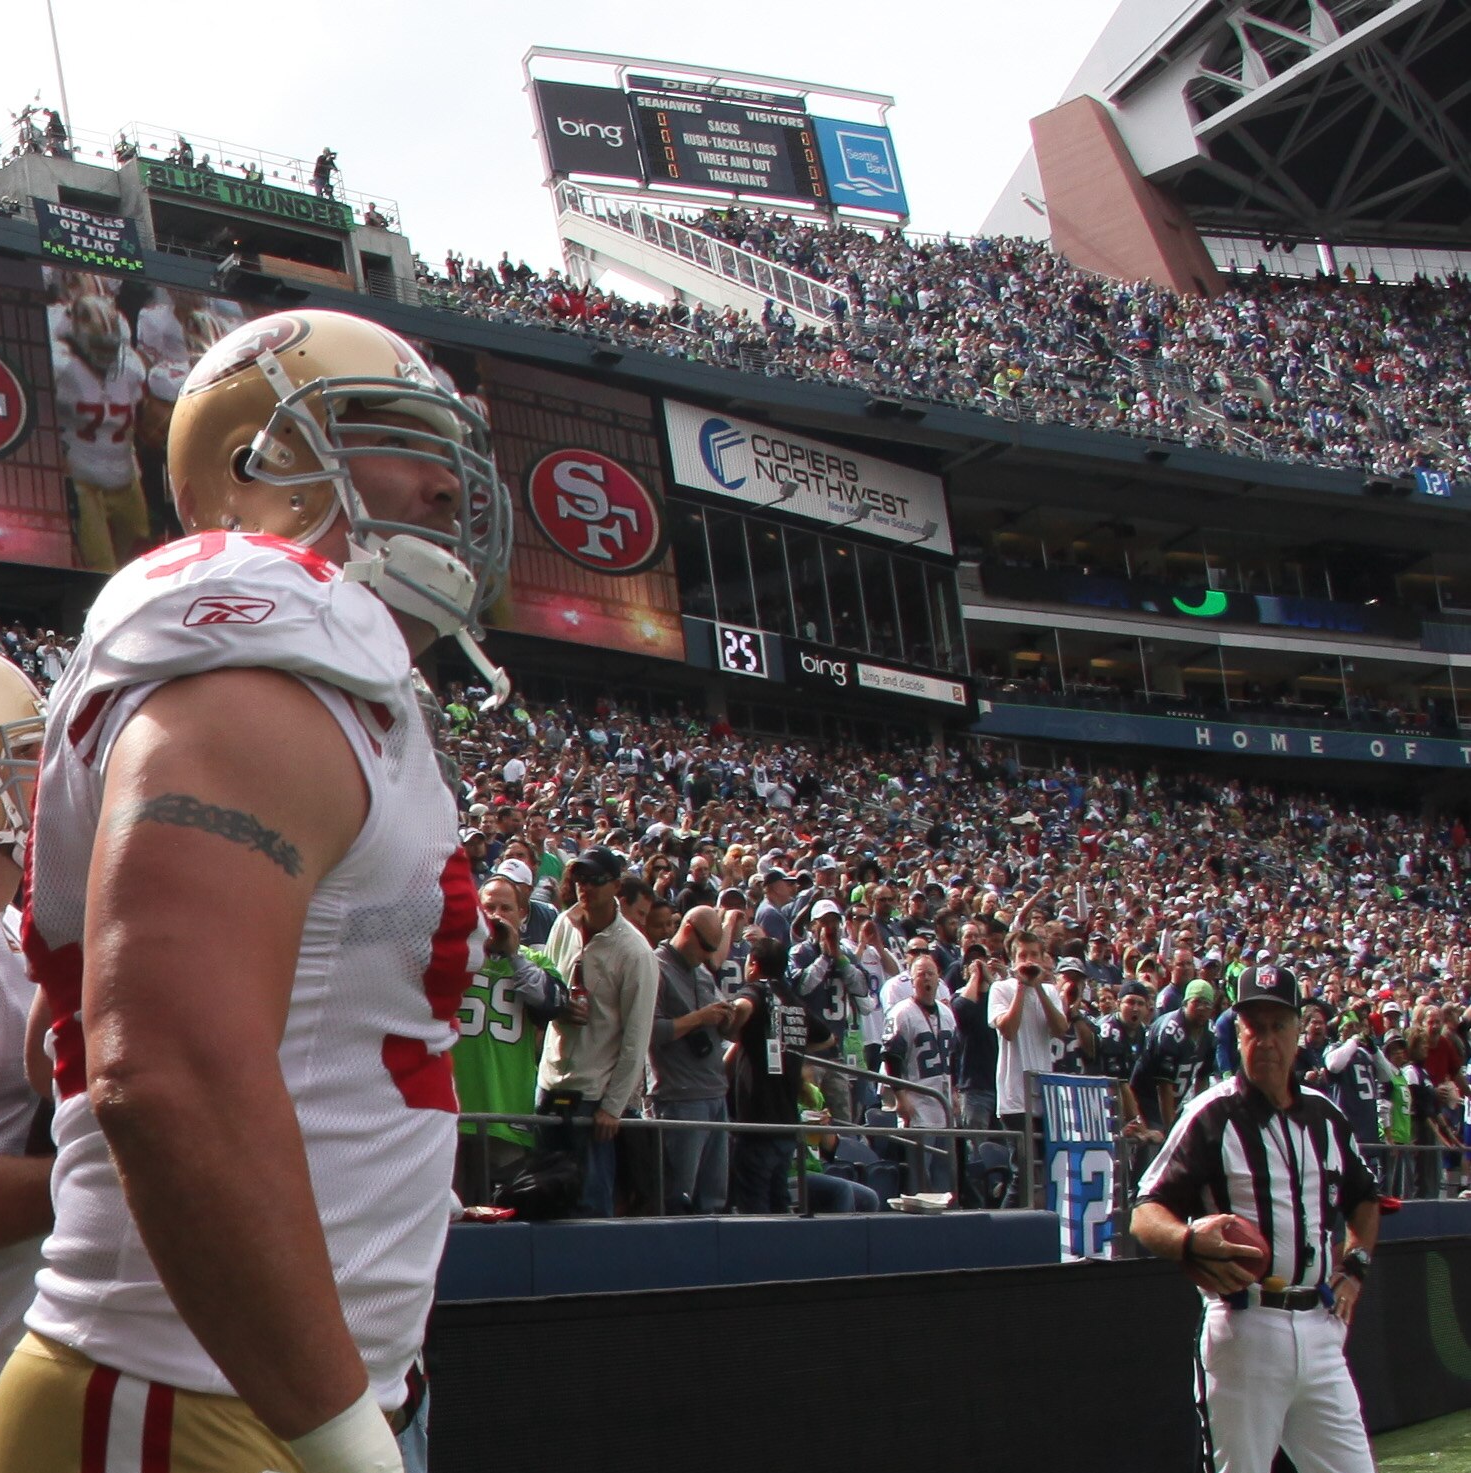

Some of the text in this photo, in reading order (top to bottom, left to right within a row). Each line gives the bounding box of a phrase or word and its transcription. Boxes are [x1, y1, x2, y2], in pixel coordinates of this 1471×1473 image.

[662, 79, 776, 103] DEFENSE
[637, 96, 805, 128] SEAHAWKS VISITORS
[708, 120, 740, 135] SACKS
[557, 117, 623, 148] bing
[696, 151, 771, 172] THREE AND OUT
[846, 148, 879, 162] Seattle
[866, 161, 889, 175] Bank
[708, 169, 768, 188] TAKEAWAYS
[149, 166, 347, 229] BLUE THUNDER
[48, 204, 125, 229] KEEPERS
[59, 218, 122, 242] OF THE
[70, 233, 116, 254] FLAG
[75, 402, 135, 443] 77
[751, 434, 858, 482] COPIERS
[755, 458, 909, 518] NORTHWEST
[553, 459, 639, 561] SF
[891, 517, 924, 534] Solution
[724, 631, 756, 672] 25
[800, 652, 848, 686] bing
[862, 671, 880, 686] bing
[882, 675, 898, 688] and
[1196, 727, 1324, 754] HOME
[1370, 739, 1417, 760] OF
[458, 973, 523, 1044] 59
[1042, 1083, 1113, 1143] VOLUME
[1049, 1148, 1114, 1263] 12
